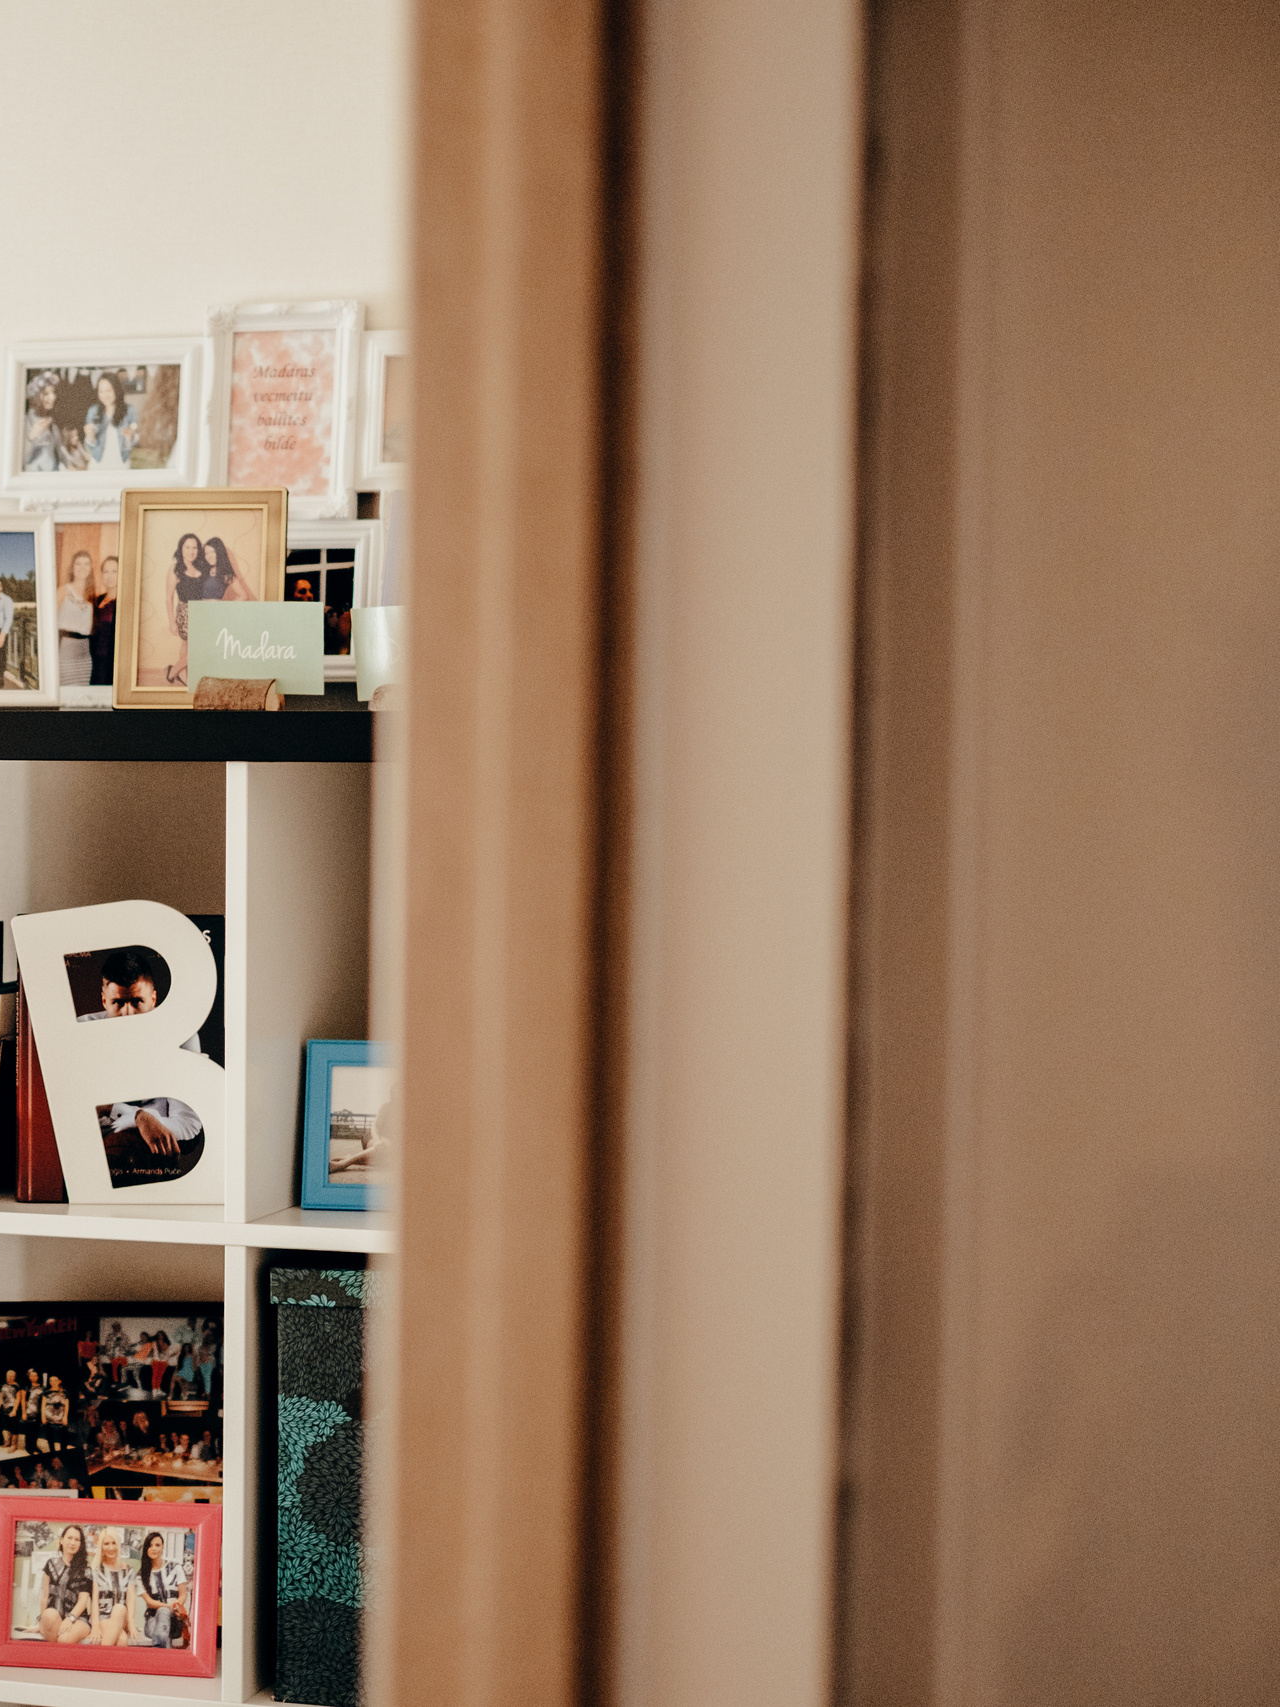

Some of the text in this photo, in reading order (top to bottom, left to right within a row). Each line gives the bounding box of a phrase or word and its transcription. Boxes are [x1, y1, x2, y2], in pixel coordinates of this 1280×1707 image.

[253, 362, 317, 379] Madaras
[253, 389, 313, 402] vecmeitu
[215, 627, 297, 662] Madara
